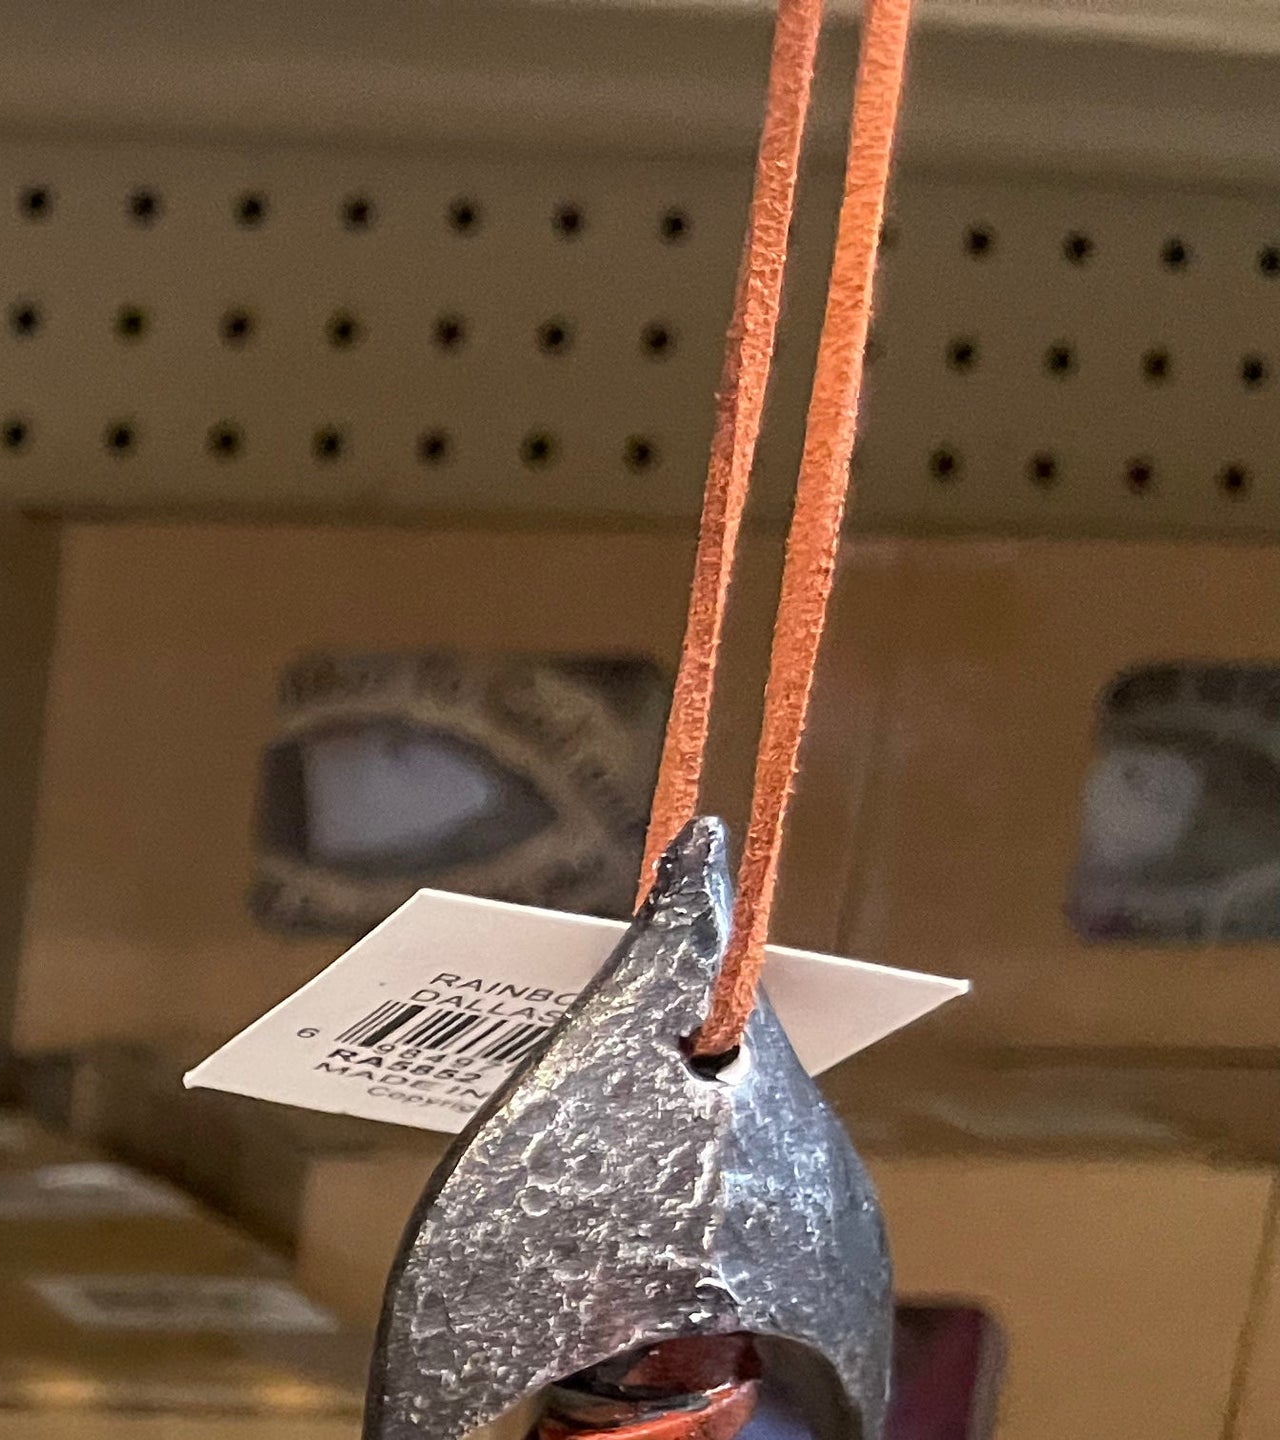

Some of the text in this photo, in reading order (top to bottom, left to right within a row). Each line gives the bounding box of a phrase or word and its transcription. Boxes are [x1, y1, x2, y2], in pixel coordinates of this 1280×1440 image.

[430, 973, 578, 1006] RAINBO
[315, 1062, 438, 1091] MADE
[328, 1049, 481, 1083] RA5852
